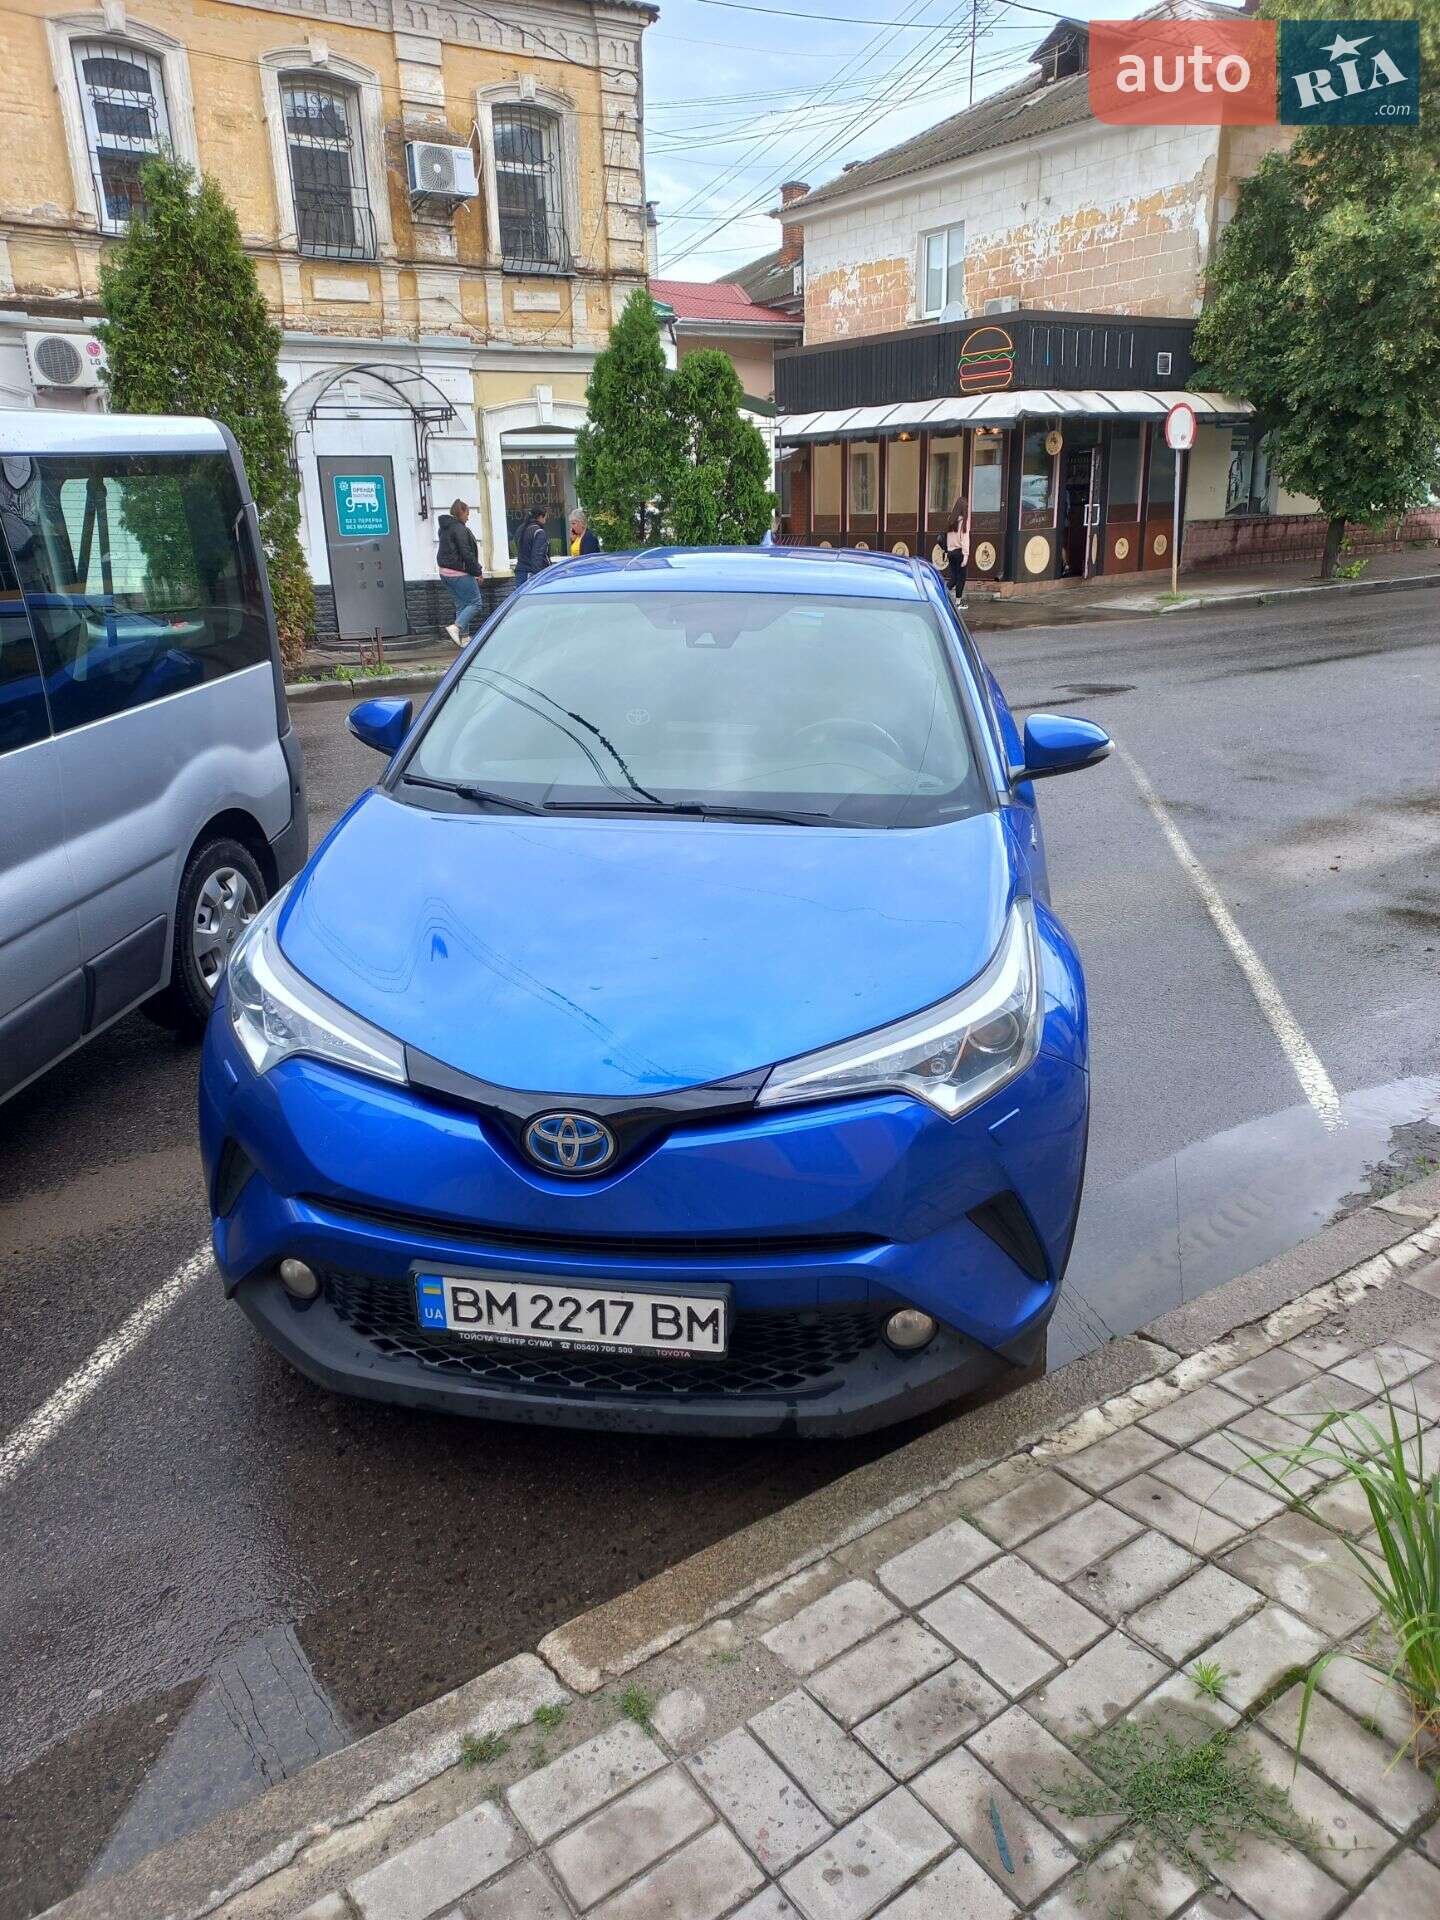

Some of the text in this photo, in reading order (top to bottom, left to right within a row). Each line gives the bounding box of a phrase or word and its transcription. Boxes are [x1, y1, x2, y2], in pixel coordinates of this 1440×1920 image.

[520, 473, 557, 488] ЗАЛ
[424, 1308, 443, 1320] UA
[530, 1293, 634, 1336] 2217
[496, 1336, 526, 1345] ЦЕНТР
[528, 1339, 552, 1348] СУМИ
[656, 1349, 691, 1358] TOYOTA
